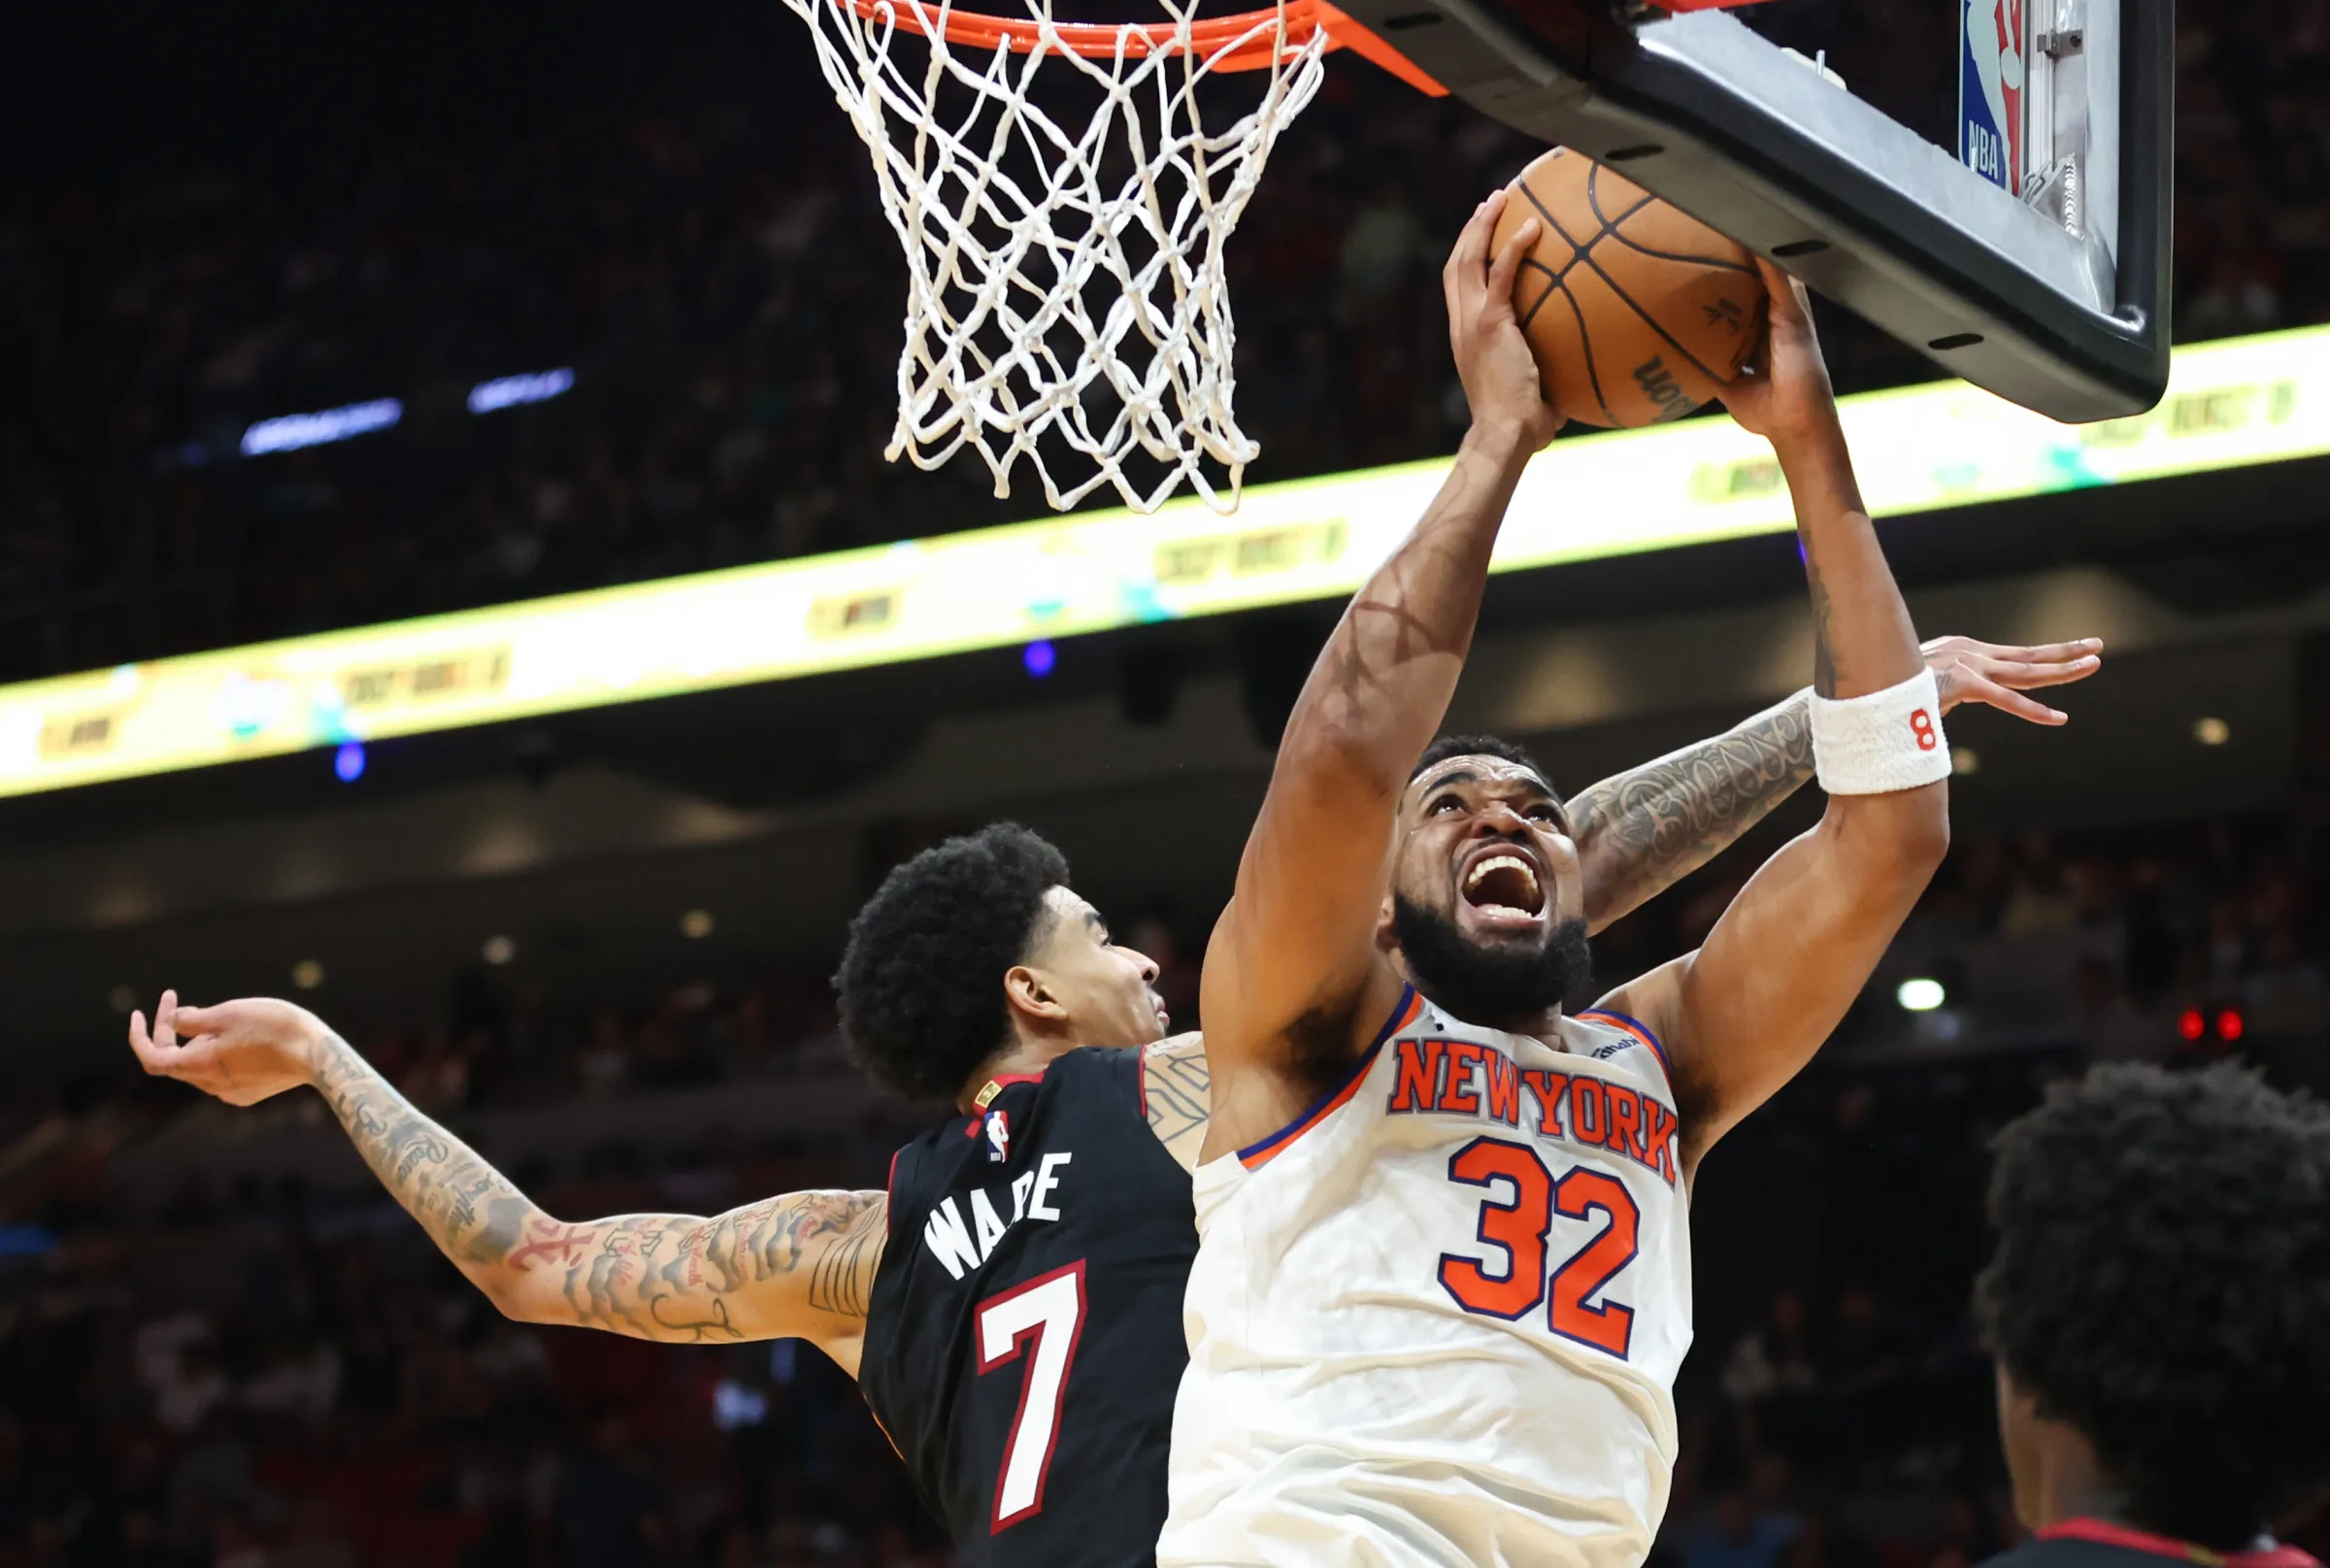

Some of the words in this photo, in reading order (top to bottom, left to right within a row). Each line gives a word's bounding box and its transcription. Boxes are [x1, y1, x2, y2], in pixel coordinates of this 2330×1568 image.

[1968, 119, 1999, 181] NBA
[1386, 1037, 1519, 1129] NEW
[1520, 1069, 1679, 1193] YORK
[1437, 1135, 1641, 1361] 32
[973, 1257, 1088, 1537] 7
